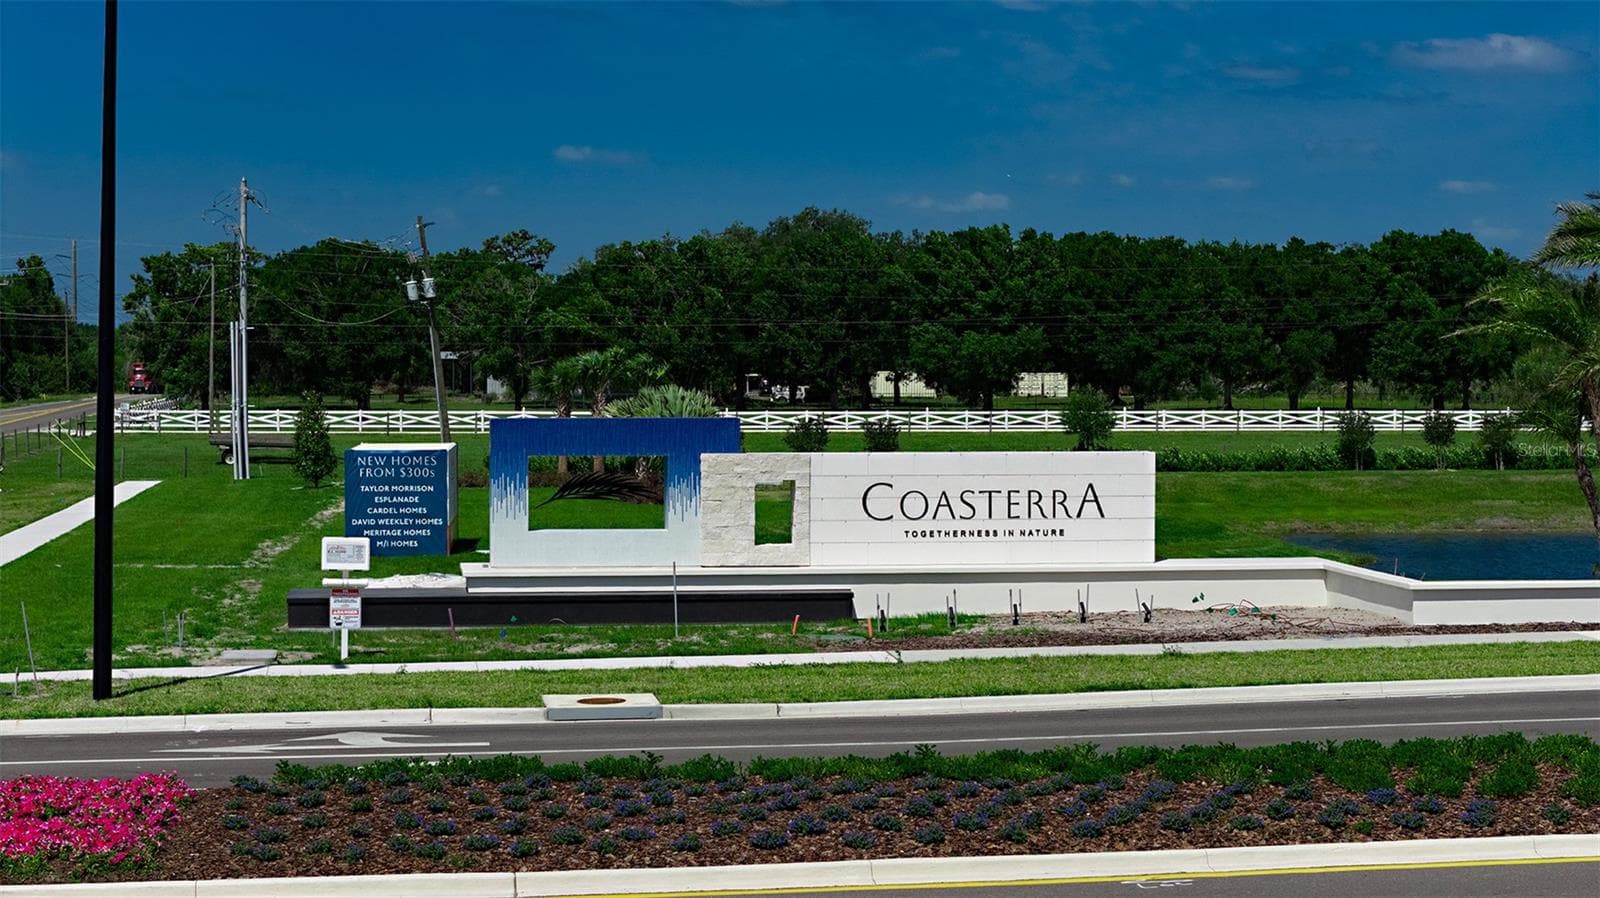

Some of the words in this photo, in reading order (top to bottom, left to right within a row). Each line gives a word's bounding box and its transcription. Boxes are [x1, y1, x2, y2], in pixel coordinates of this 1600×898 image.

[357, 456, 387, 466] NEW
[391, 456, 437, 466] HOMES
[359, 467, 395, 478] FROM
[862, 482, 1105, 521] COASTERRA
[904, 530, 998, 538] TOGETHERNESS
[1019, 529, 1065, 537] NATURE
[376, 540, 389, 548] M/I
